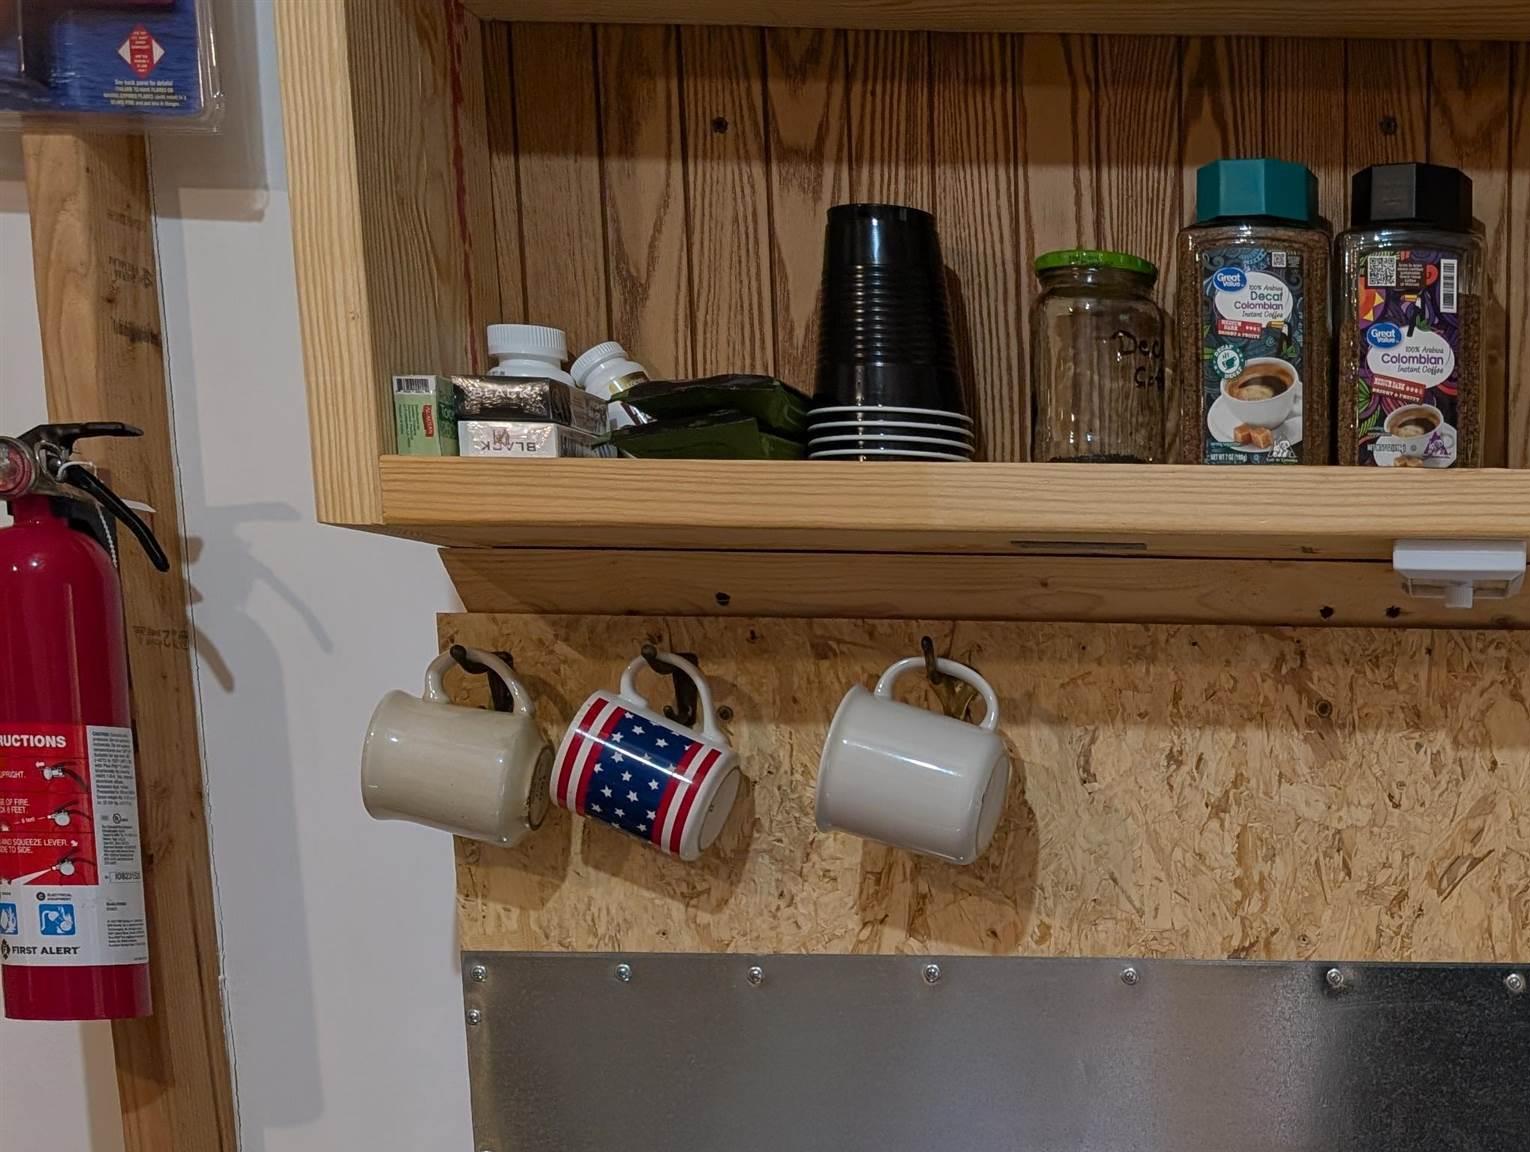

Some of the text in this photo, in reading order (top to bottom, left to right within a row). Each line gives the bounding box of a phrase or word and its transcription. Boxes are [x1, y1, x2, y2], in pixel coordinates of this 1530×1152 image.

[1216, 272, 1241, 281] Great
[1250, 291, 1284, 302] Decaf
[1234, 301, 1284, 310] Colombian
[1264, 311, 1284, 319] Coffee
[1370, 328, 1396, 338] Great
[1381, 353, 1444, 365] Colombian
[1398, 365, 1444, 375] Instant Coffee
[473, 388, 531, 399] BLACK
[480, 441, 536, 452] BLACK
[12, 946, 79, 955] FIRST ALERT
